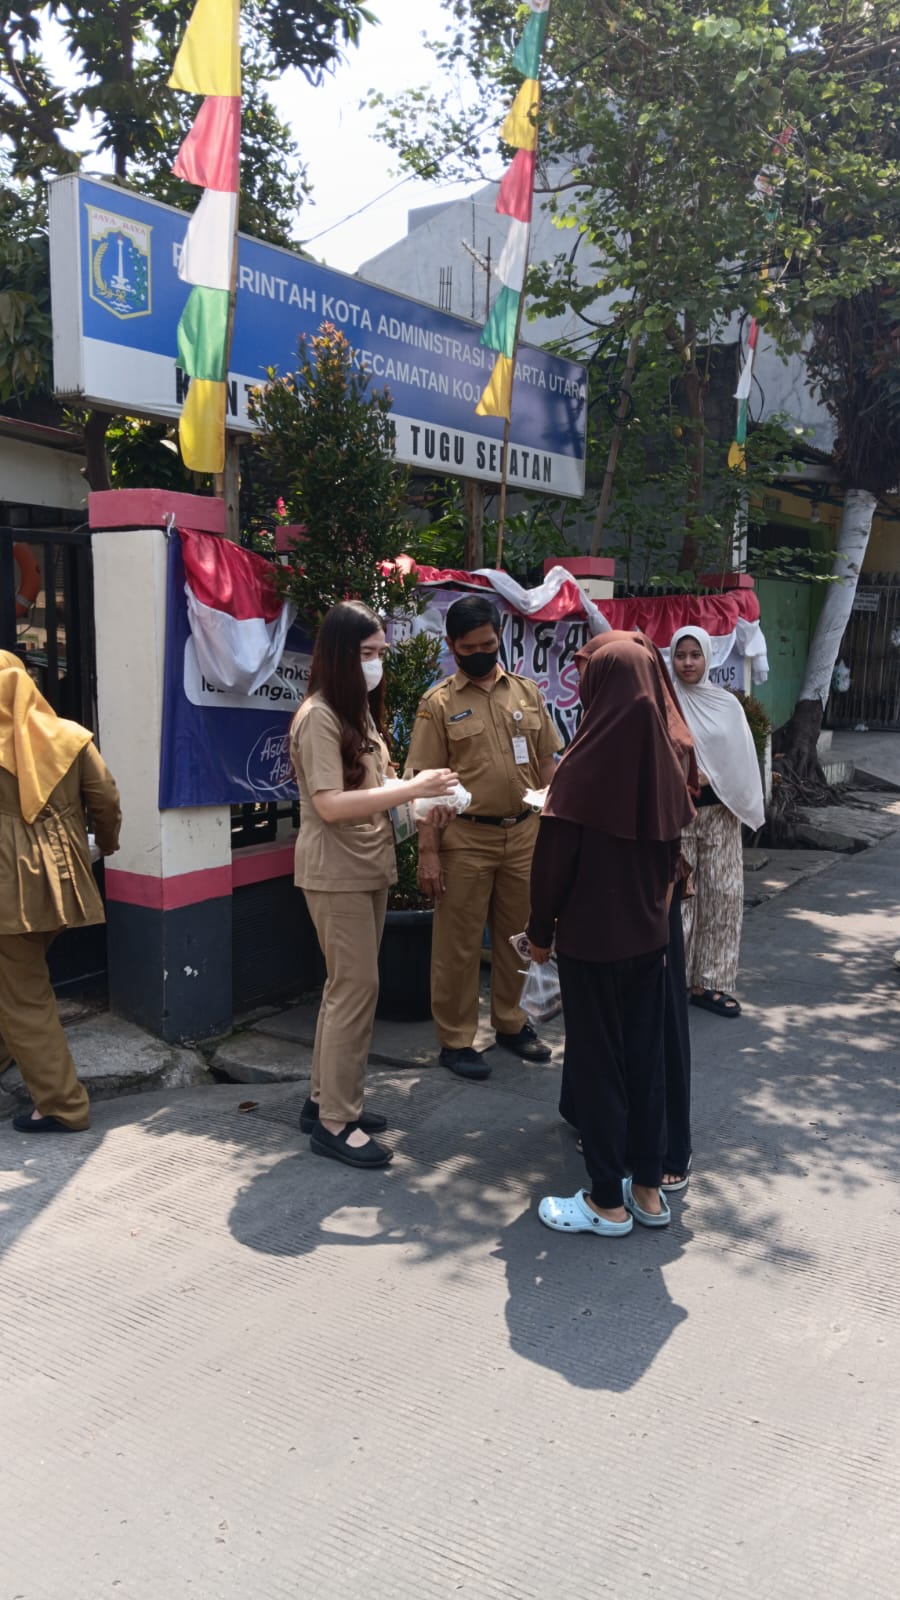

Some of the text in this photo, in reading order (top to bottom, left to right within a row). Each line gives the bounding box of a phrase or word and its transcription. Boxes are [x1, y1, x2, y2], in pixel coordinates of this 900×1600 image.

[92, 212, 147, 236] JAYA RAYA
[172, 241, 586, 401] PRINTAH KOTA ADMINISTRASI JARTA UTARA
[349, 346, 482, 404] KECAMATAN KOJ
[410, 425, 465, 465] TUGU
